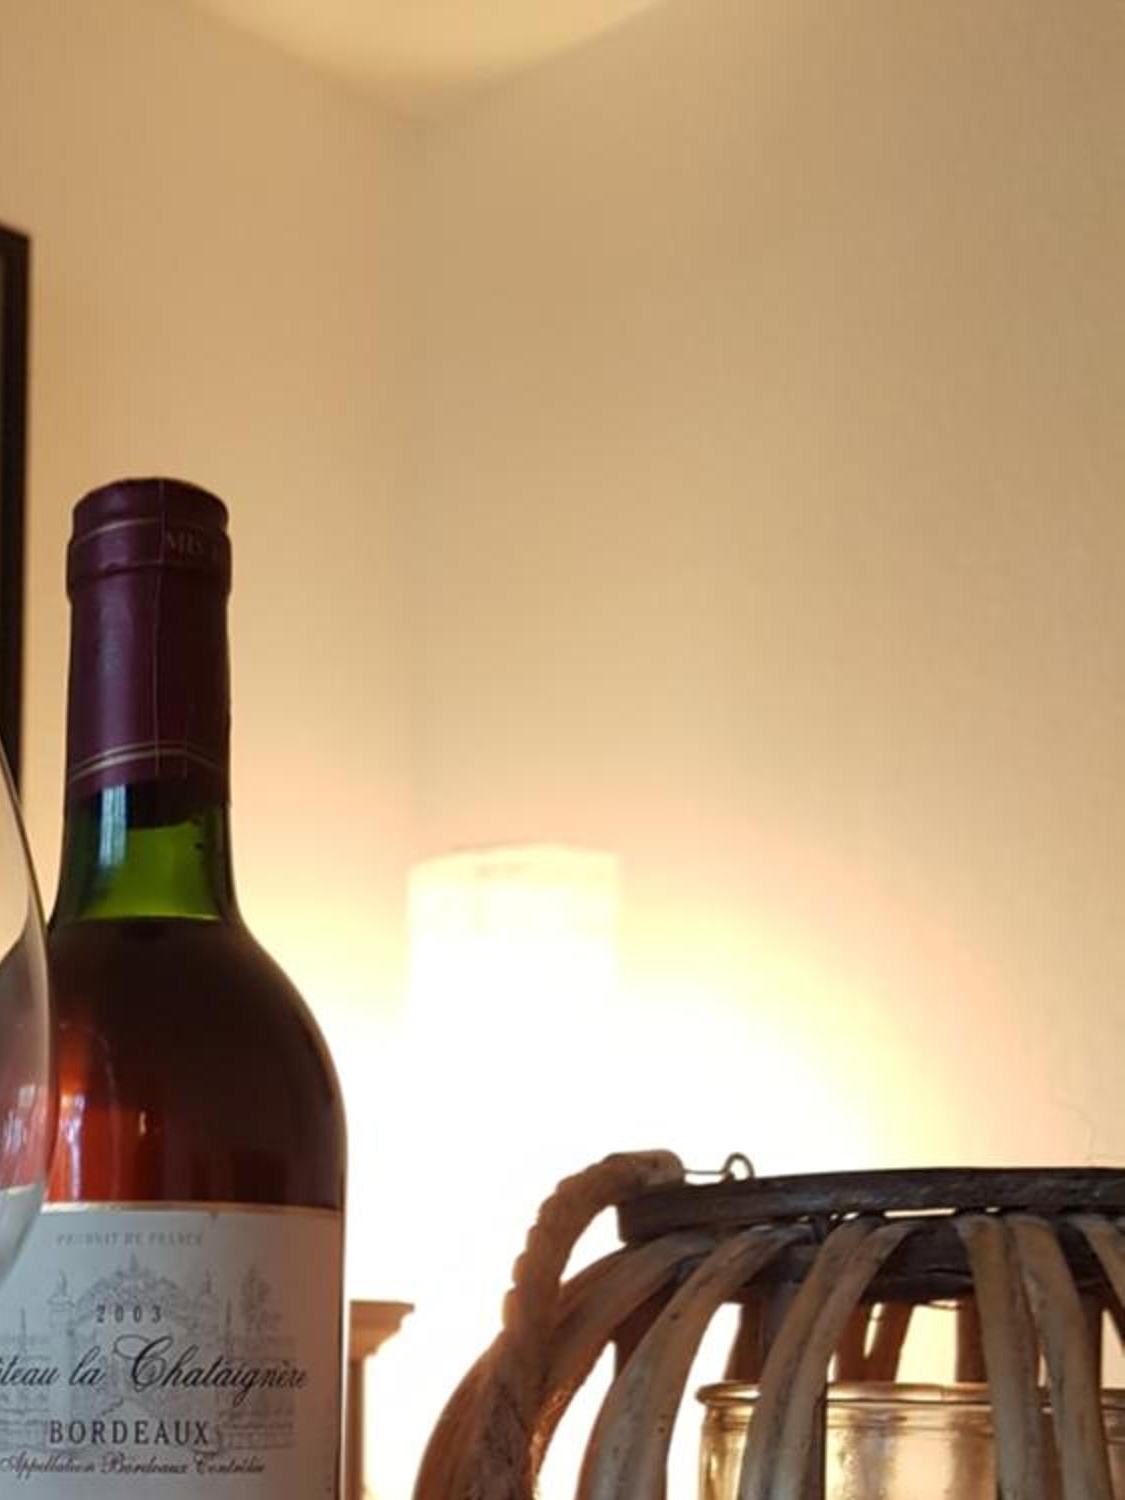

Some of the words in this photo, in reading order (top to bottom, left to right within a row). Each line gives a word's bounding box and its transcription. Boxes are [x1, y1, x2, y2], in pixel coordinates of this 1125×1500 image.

[148, 1231, 203, 1246] FRANCE
[96, 1304, 161, 1323] 2003
[69, 1346, 107, 1387] la
[49, 1420, 211, 1445] BORDEAUX
[101, 1451, 188, 1475] Bordeaux
